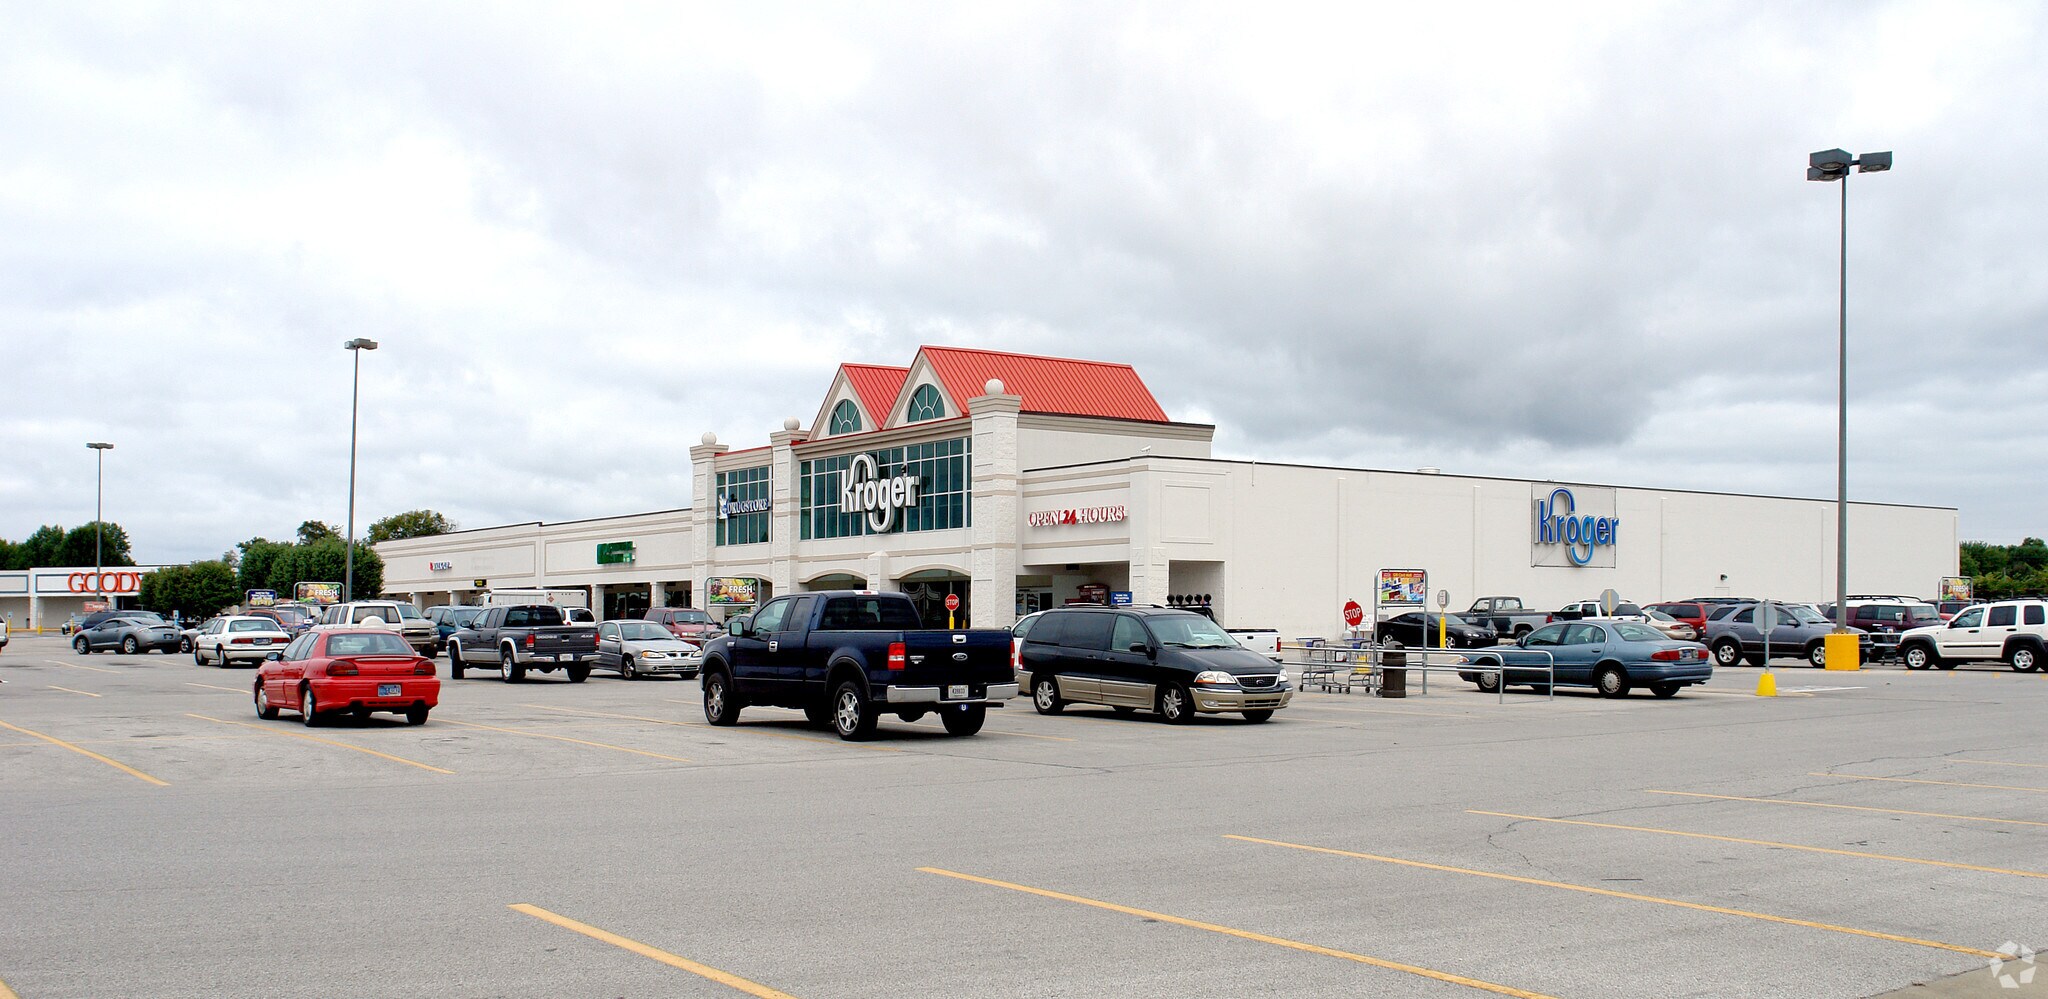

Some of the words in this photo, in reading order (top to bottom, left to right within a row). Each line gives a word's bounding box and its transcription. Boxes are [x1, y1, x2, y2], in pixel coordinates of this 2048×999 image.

[841, 454, 917, 532] Kroger
[727, 498, 768, 514] DRUGSTORE
[1028, 510, 1061, 527] OPEN
[1062, 509, 1077, 525] 24
[1078, 505, 1125, 523] HOURS
[1536, 487, 1619, 566] Kroger
[728, 585, 753, 593] FRESH
[1344, 607, 1361, 620] STOP
